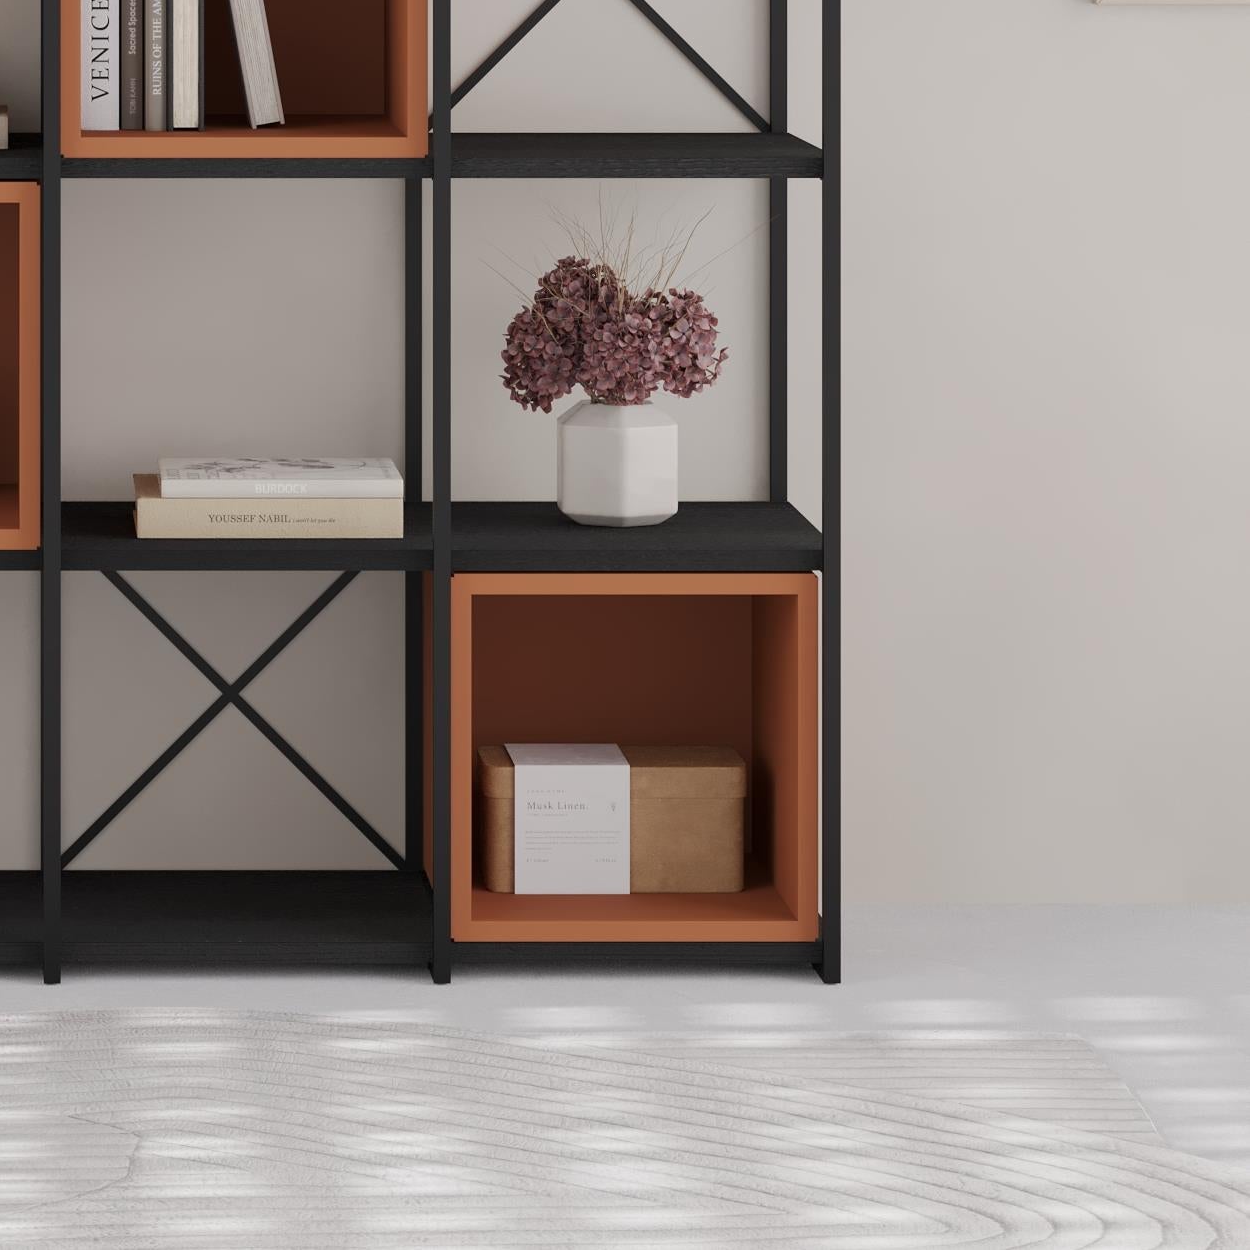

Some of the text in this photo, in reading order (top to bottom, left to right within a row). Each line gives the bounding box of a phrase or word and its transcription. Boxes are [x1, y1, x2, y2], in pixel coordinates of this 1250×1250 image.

[153, 17, 162, 40] THE
[128, 27, 137, 55] Sacred
[153, 43, 162, 58] OF
[153, 60, 162, 95] RUINS
[208, 514, 256, 523] YOUSSEF
